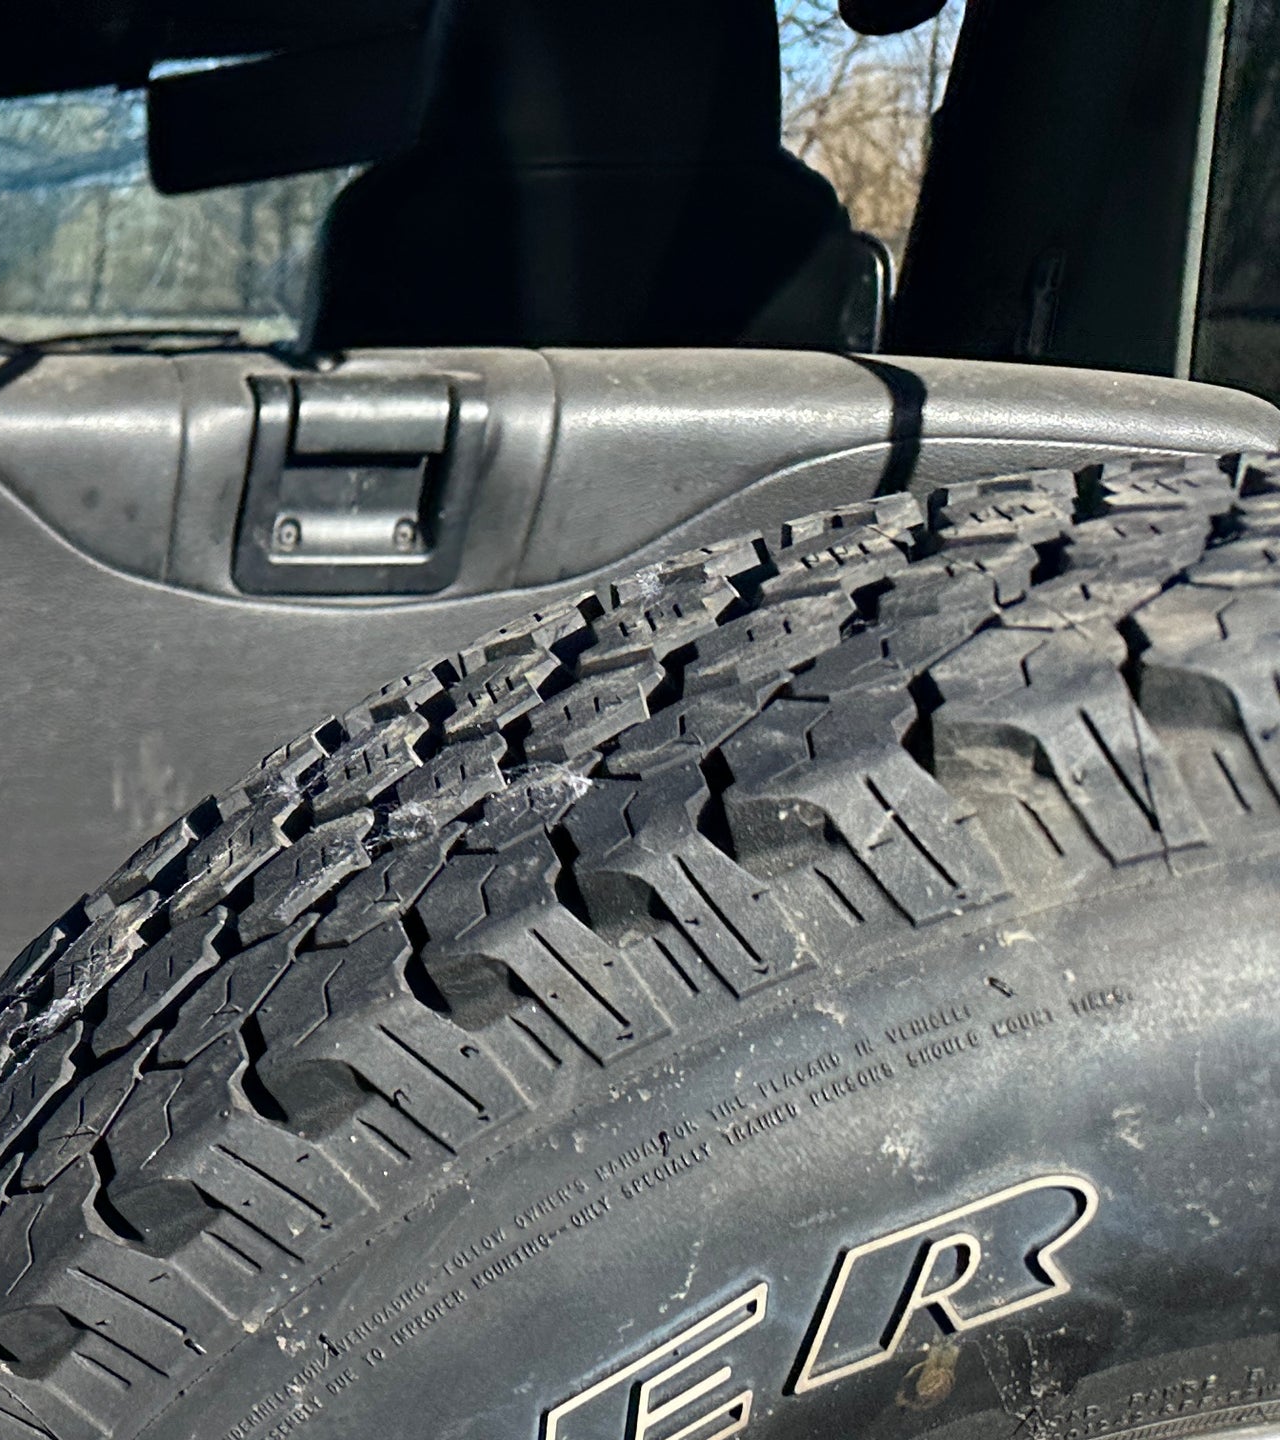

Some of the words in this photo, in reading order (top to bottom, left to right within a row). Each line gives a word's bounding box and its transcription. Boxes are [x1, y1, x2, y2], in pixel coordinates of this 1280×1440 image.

[325, 1367, 356, 1396] DUE
[362, 1347, 386, 1368] TO
[390, 1288, 468, 1347] IMPROPER
[570, 1195, 611, 1228] ONLY
[621, 1141, 712, 1200] SPECIALLY
[722, 1102, 801, 1146] TRAINED
[442, 1227, 506, 1276] FOLLOW
[674, 1119, 699, 1140] OR
[706, 1095, 748, 1122] TIRE
